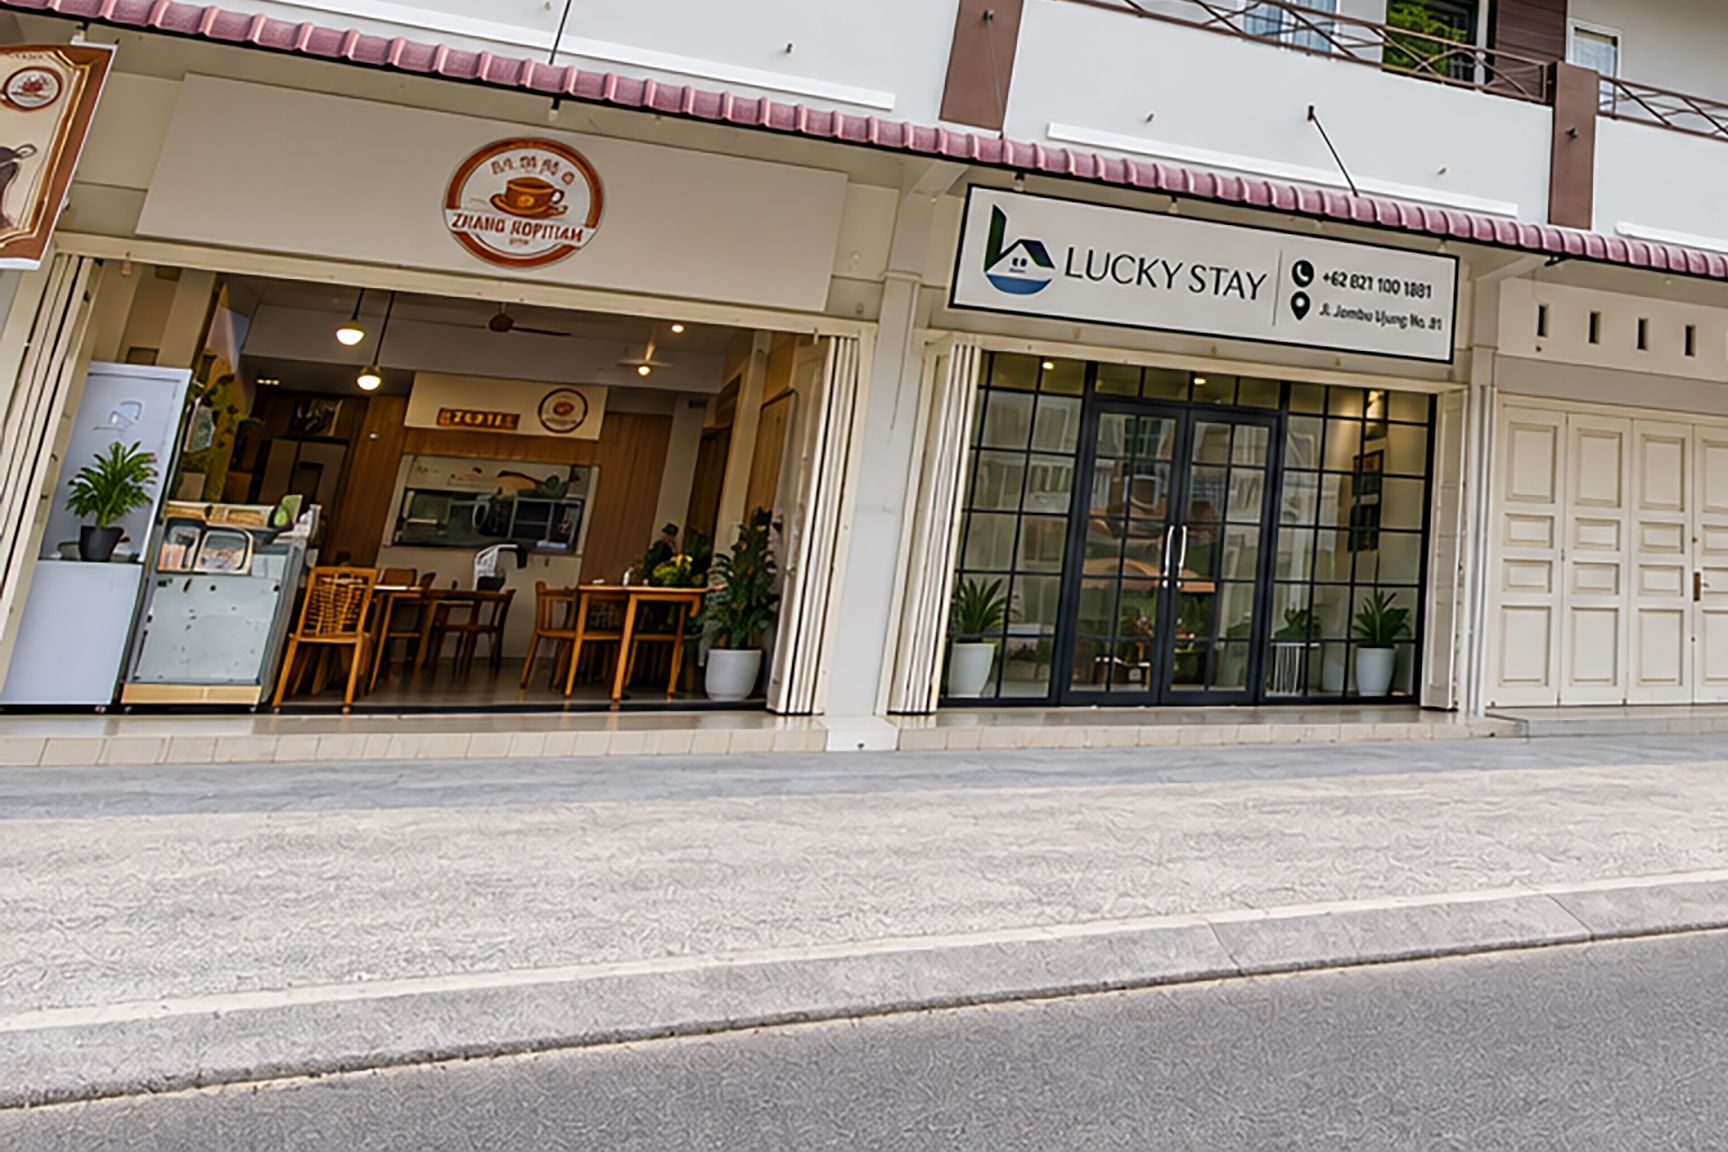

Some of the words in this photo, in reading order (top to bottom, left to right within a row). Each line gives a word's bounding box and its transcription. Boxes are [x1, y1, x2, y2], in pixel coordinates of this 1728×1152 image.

[452, 212, 505, 233] ZHANG
[1064, 246, 1184, 290] LUCKY
[1188, 263, 1268, 301] STAY
[1322, 270, 1348, 288] +62
[1377, 278, 1400, 295] 100
